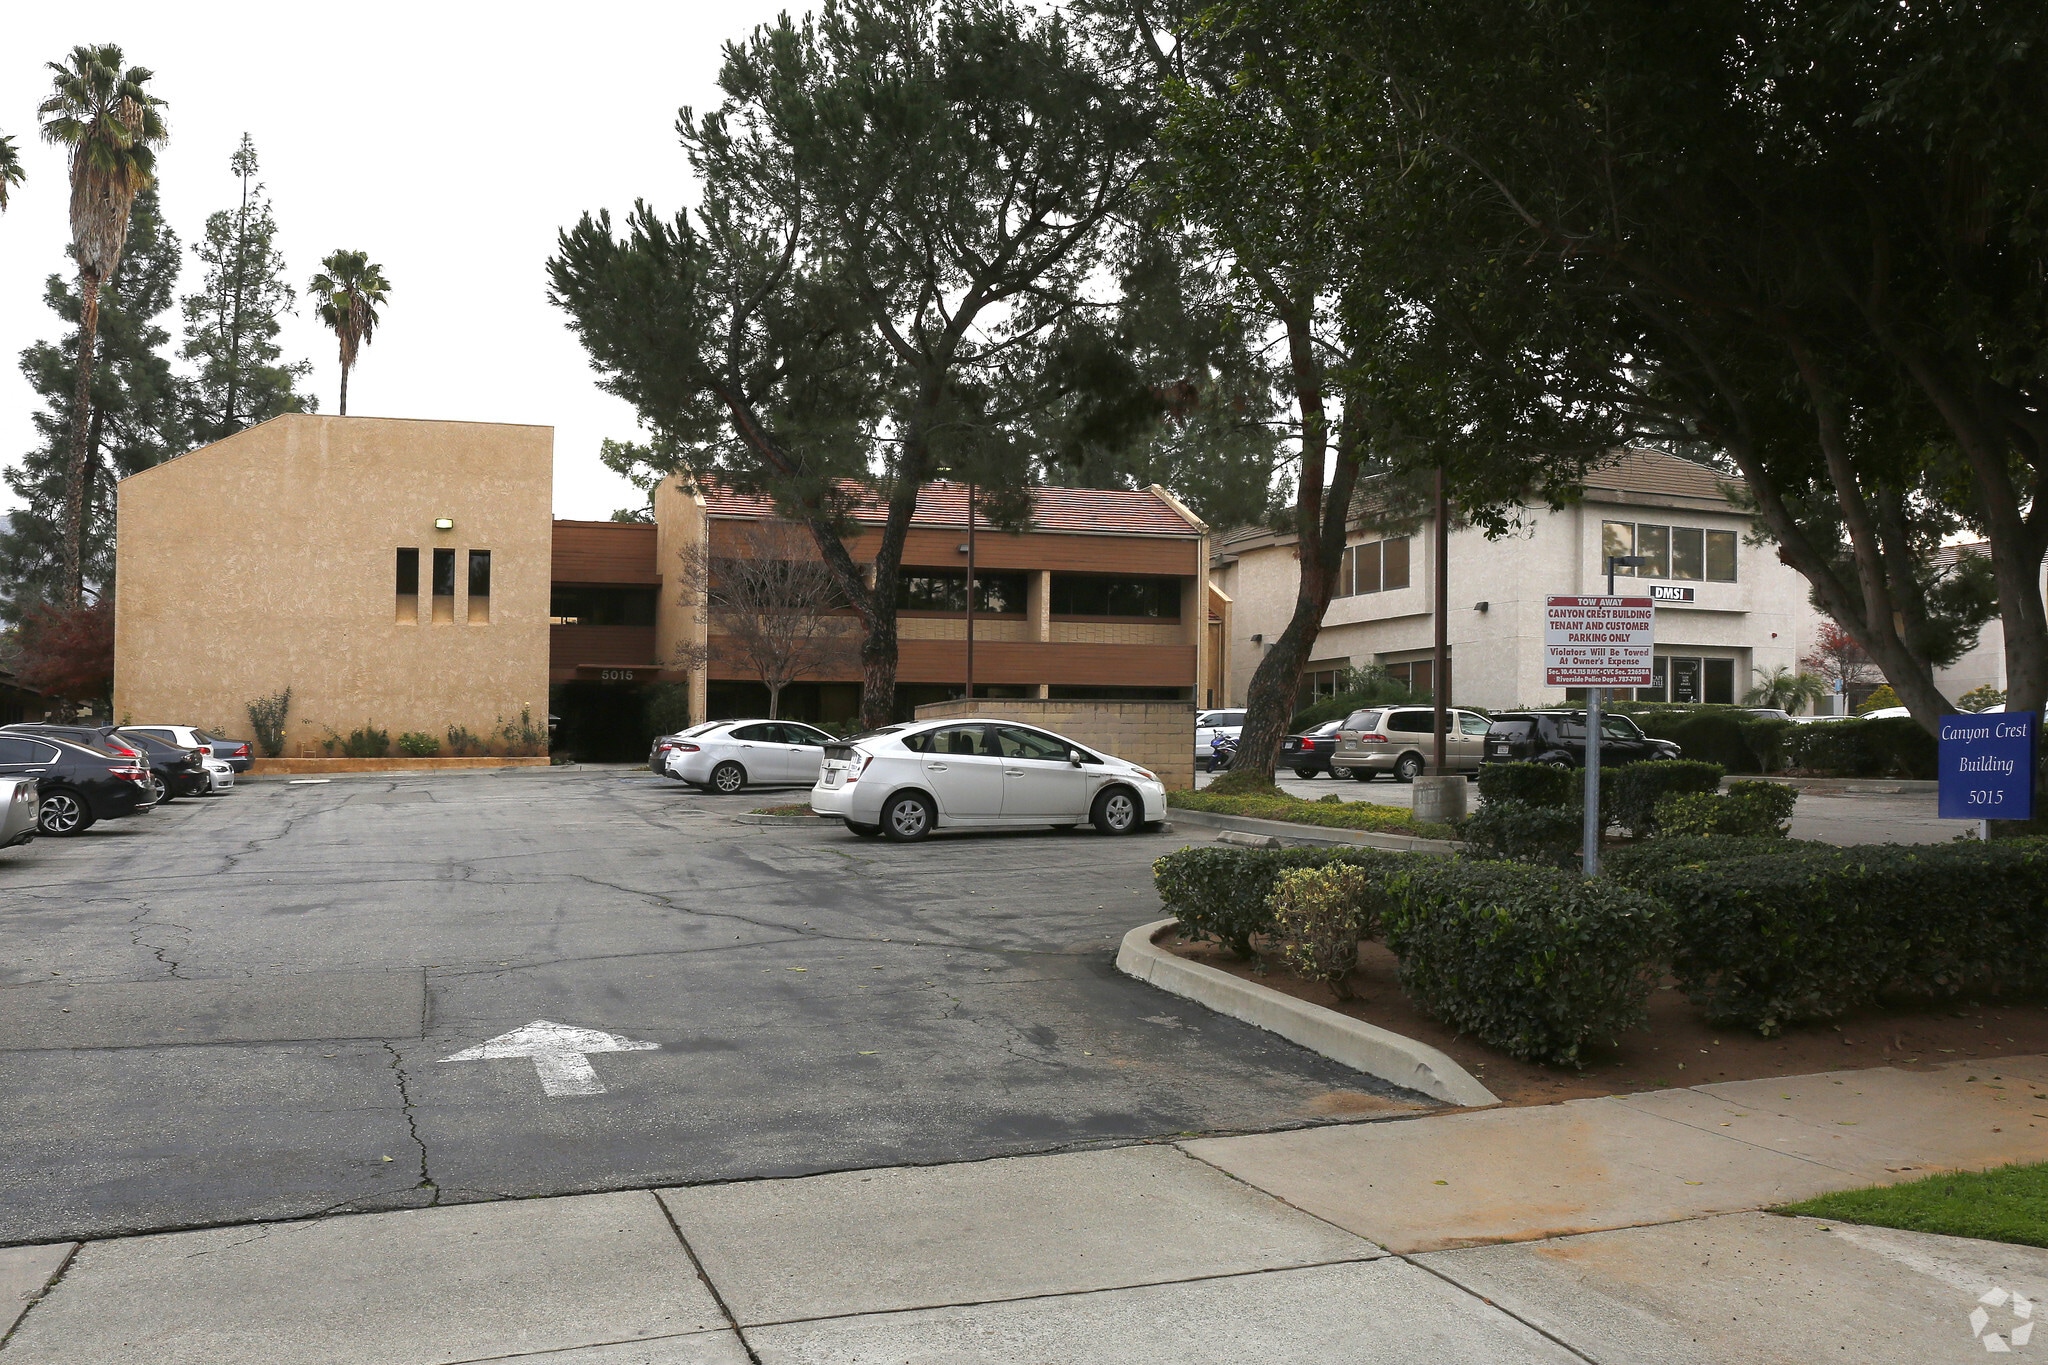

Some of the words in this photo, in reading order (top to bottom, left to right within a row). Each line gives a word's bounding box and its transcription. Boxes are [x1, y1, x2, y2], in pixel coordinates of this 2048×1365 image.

[1655, 587, 1684, 600] DMSI
[1578, 598, 1597, 606] TOW
[1548, 609, 1585, 618] CANYON
[1586, 610, 1611, 619] CREST
[1612, 610, 1652, 619] BUILDING
[1550, 621, 1584, 630] TENANT
[1585, 622, 1604, 630] AND
[1605, 622, 1649, 631] CUSTOMER
[1568, 633, 1607, 642] PARKING
[1609, 634, 1631, 642] ONLY
[1550, 648, 1587, 656] Violators
[1590, 648, 1606, 656] Will
[1610, 648, 1620, 656] Be
[1623, 648, 1649, 656] Towed
[1559, 657, 1568, 665] At
[1572, 657, 1604, 665] Owner's
[1608, 657, 1640, 666] Expense
[601, 670, 633, 680] 5015
[1942, 725, 1989, 744] Canyon
[1995, 722, 2027, 738] Crest
[1959, 756, 2014, 776] Building
[1968, 790, 2004, 804] 5015
